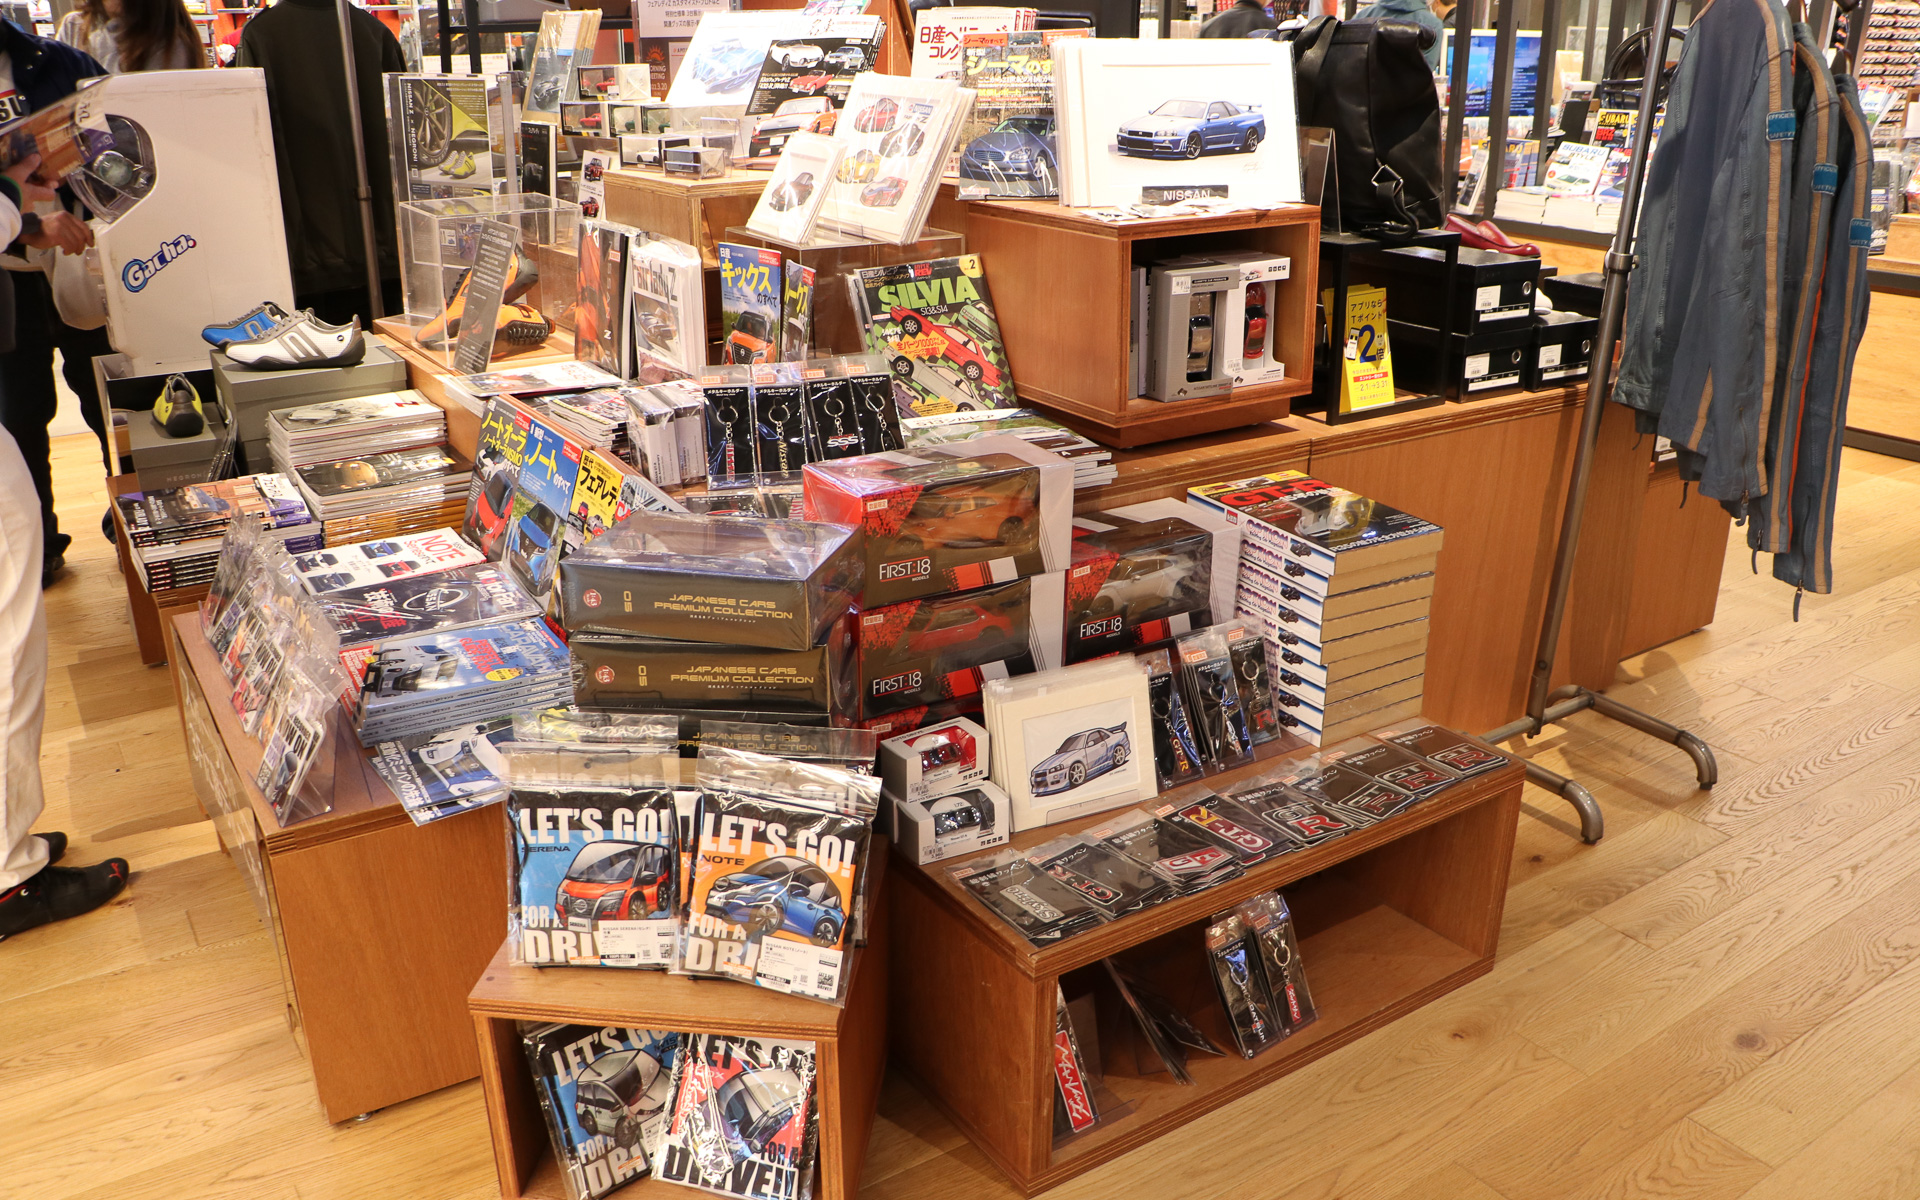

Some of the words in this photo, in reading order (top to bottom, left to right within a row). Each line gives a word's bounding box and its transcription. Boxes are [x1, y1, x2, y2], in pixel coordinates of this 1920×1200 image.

[1562, 143, 1606, 156] SUBARU
[1163, 189, 1211, 201] NISSAN
[915, 267, 933, 277] REV
[969, 258, 976, 270] 2
[721, 258, 772, 295] キックス
[757, 293, 778, 308] のすべて
[878, 276, 981, 313] SILVIA
[1351, 299, 1383, 312] アプリなら
[920, 304, 949, 316] S13&S14
[1351, 311, 1383, 324] Tポイント
[1359, 324, 1377, 364] 2
[482, 411, 528, 452] ノートオーラ
[827, 435, 859, 448] SSS
[528, 441, 558, 481] ノート
[778, 439, 790, 478] Nissan
[1220, 479, 1335, 506] GT-R
[416, 533, 467, 562] NOTE
[879, 557, 931, 581] FIRST:18
[654, 601, 711, 614] PREMIUM
[713, 606, 793, 620] COLLECTION
[669, 593, 737, 607] JAPANESE
[739, 599, 776, 609] CARS
[1080, 617, 1123, 638] FIRST:18
[501, 622, 553, 673] CARAVAN
[670, 674, 732, 684] PREMIUM
[733, 675, 814, 684] COLLECTION
[686, 665, 757, 675] JAPANESE
[759, 666, 797, 675] CARS
[873, 671, 923, 695] FIRST:18
[693, 731, 760, 742] JAPANESE
[1434, 745, 1470, 762] GT
[1451, 750, 1495, 769] R
[1382, 763, 1421, 781] GT
[1398, 770, 1445, 790] R
[1347, 784, 1380, 808] GT
[1362, 791, 1405, 813] R
[521, 807, 604, 845] LET'S
[612, 807, 671, 842] GO!
[1190, 805, 1264, 850] GT-R
[1288, 814, 1348, 836] R
[521, 845, 571, 853] SERENA
[701, 811, 788, 860] LET'S
[796, 833, 856, 879] GO!
[701, 854, 745, 866] NOTE
[1047, 863, 1115, 901] GT-R
[1005, 885, 1060, 920] Skyline
[522, 905, 550, 928] FOR
[690, 911, 728, 939] FOR
[552, 1027, 625, 1087] LET'S
[578, 1140, 605, 1165] FOR
